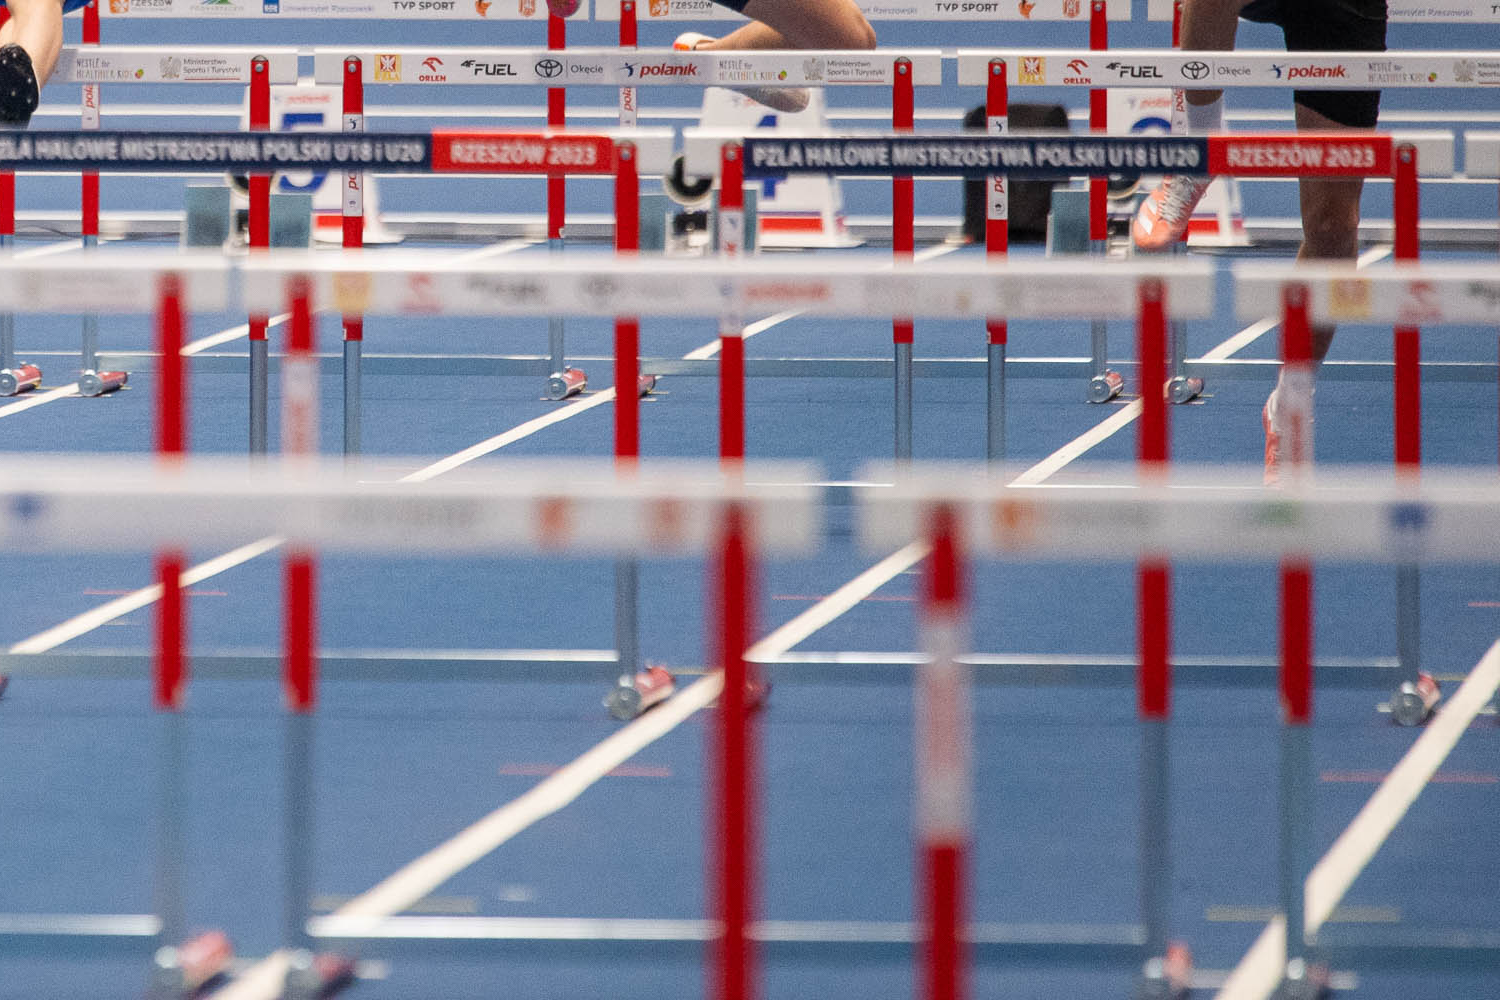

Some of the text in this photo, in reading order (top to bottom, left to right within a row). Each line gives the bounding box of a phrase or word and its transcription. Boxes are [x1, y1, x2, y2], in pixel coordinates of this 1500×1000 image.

[393, 1, 455, 11] TVP SPORT
[935, 3, 999, 12] TVP SPORT
[474, 63, 518, 77] FUEL
[570, 64, 604, 75] Okęcie
[639, 62, 698, 79] polanik
[1119, 65, 1164, 78] FUEL
[1217, 66, 1251, 77] Okęcie
[1287, 63, 1346, 81] polanik
[1063, 77, 1092, 85] ORLEN
[35, 138, 118, 161] HALOWE
[120, 138, 260, 161] MISTRZOSTWA
[262, 138, 331, 161] POLSKI
[334, 138, 371, 161] U18
[384, 138, 424, 161] U20
[450, 138, 597, 164] RZESZÓW 2023
[752, 144, 803, 168] PZLA
[805, 144, 890, 168] HALOWE
[892, 144, 1033, 168] MISTRZOSTWA
[1035, 144, 1106, 168] POLSKI
[1107, 144, 1147, 168] U18
[1161, 144, 1200, 168] U20
[1226, 139, 1376, 169] RZESZÓW 2023
